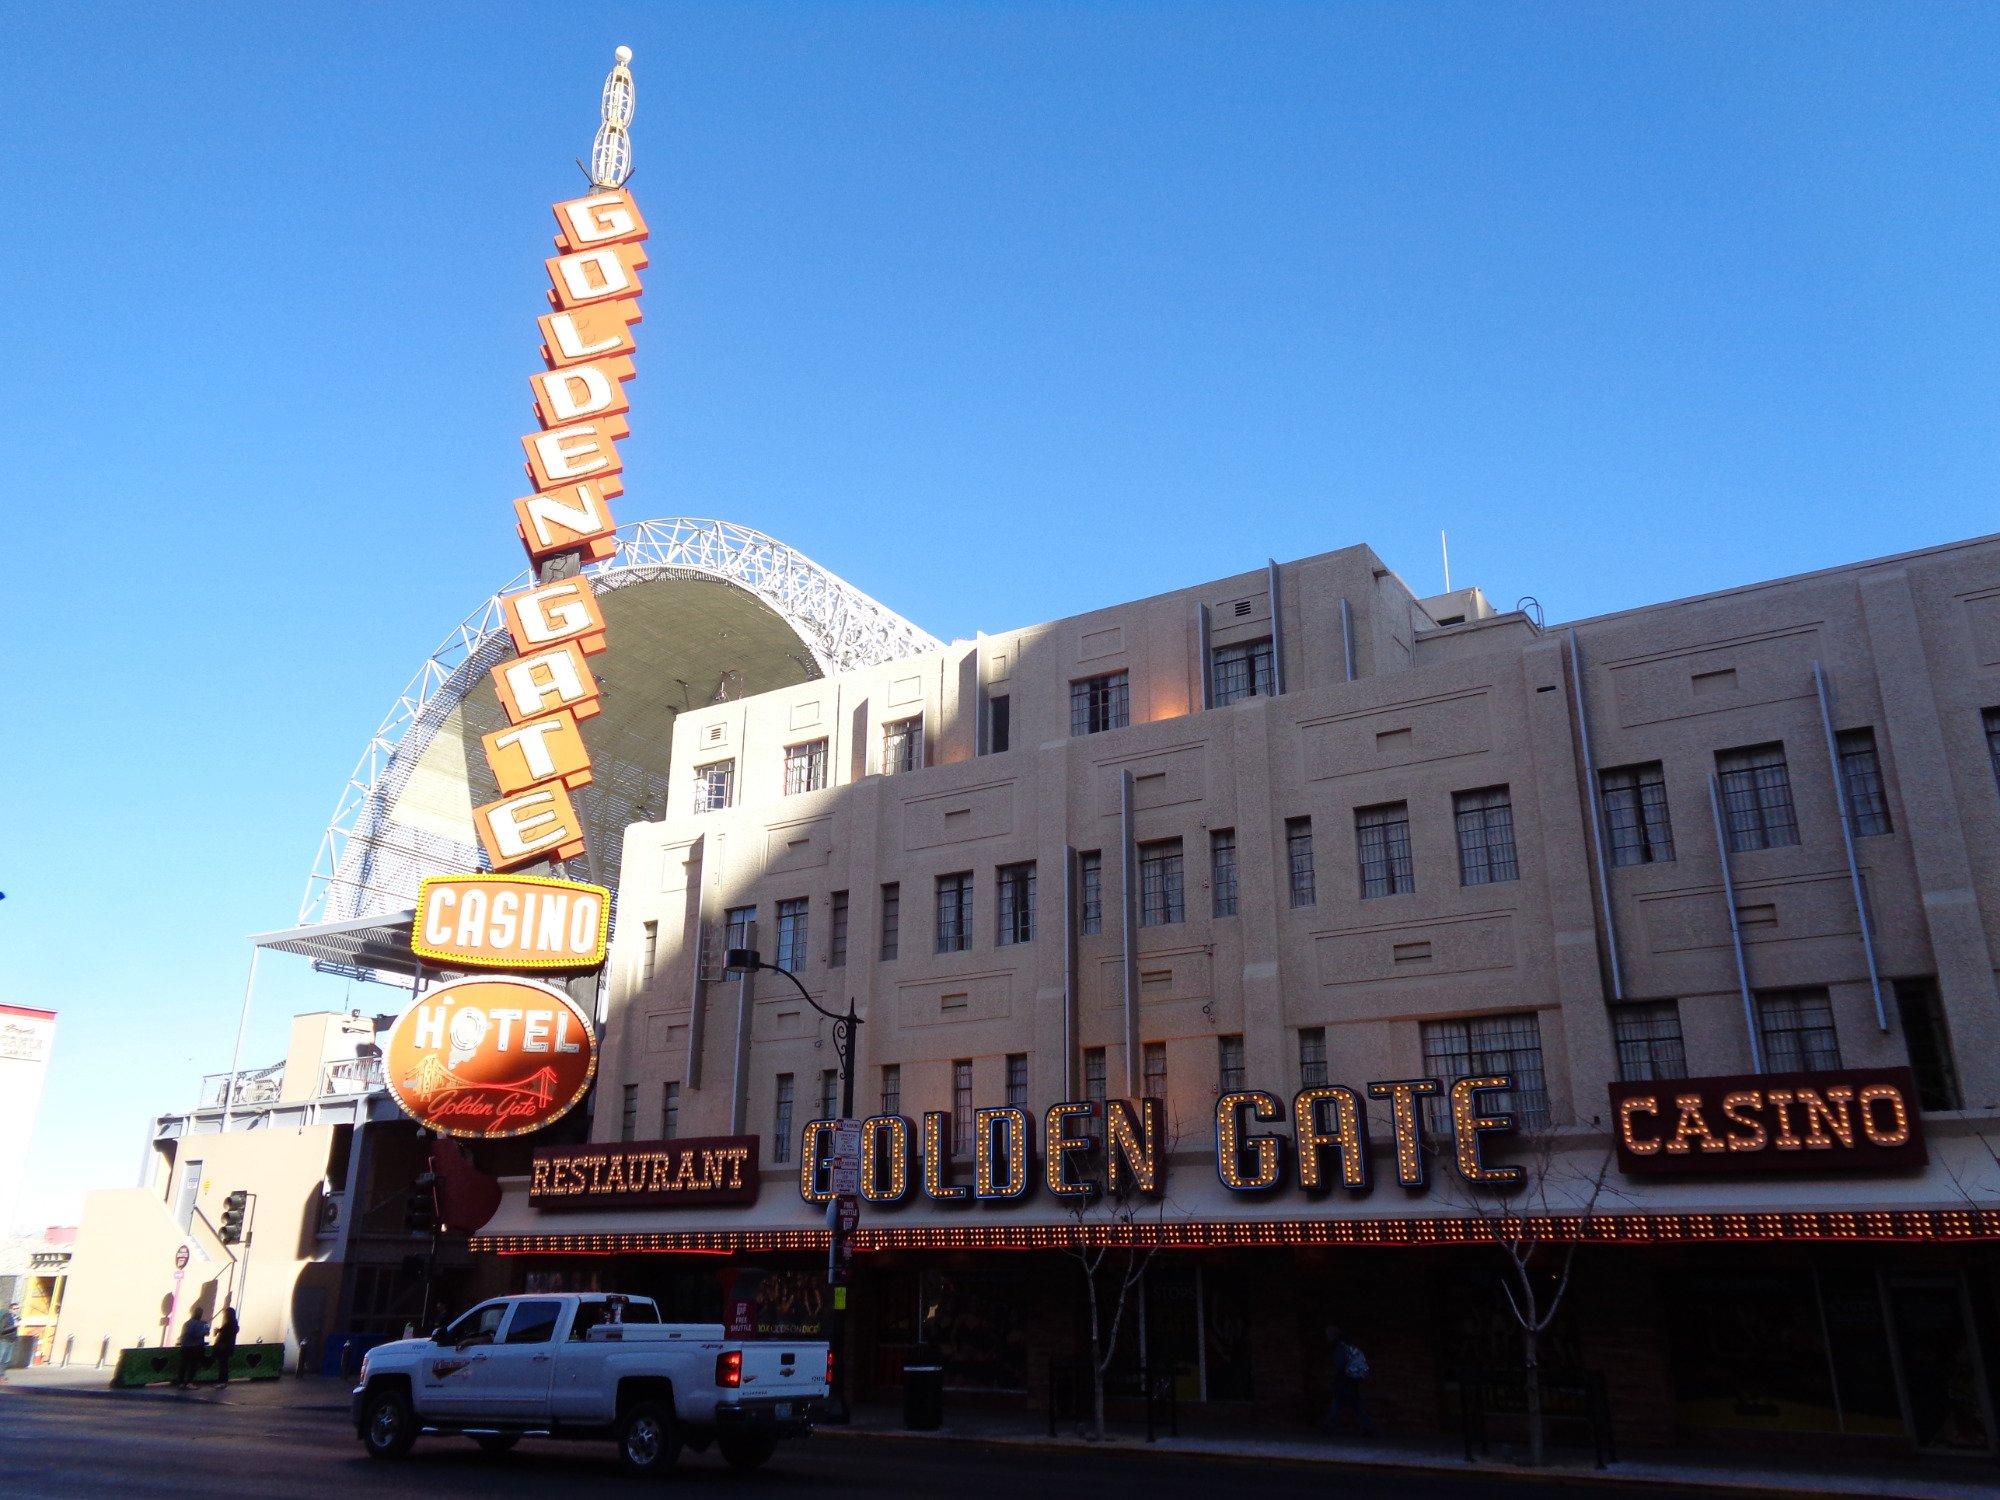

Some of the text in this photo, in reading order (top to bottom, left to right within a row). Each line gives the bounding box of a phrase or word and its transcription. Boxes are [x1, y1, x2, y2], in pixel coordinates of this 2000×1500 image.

[526, 194, 637, 548] GOLDEN
[485, 582, 593, 860] GATE
[424, 886, 598, 955] CASINO
[414, 1003, 580, 1053] HOTEL
[427, 1089, 538, 1131] Golden Gate
[800, 1073, 1526, 1203] GOLDEN GATE
[1620, 1083, 1911, 1156] CASINO
[529, 1148, 749, 1197] RESTAURANT
